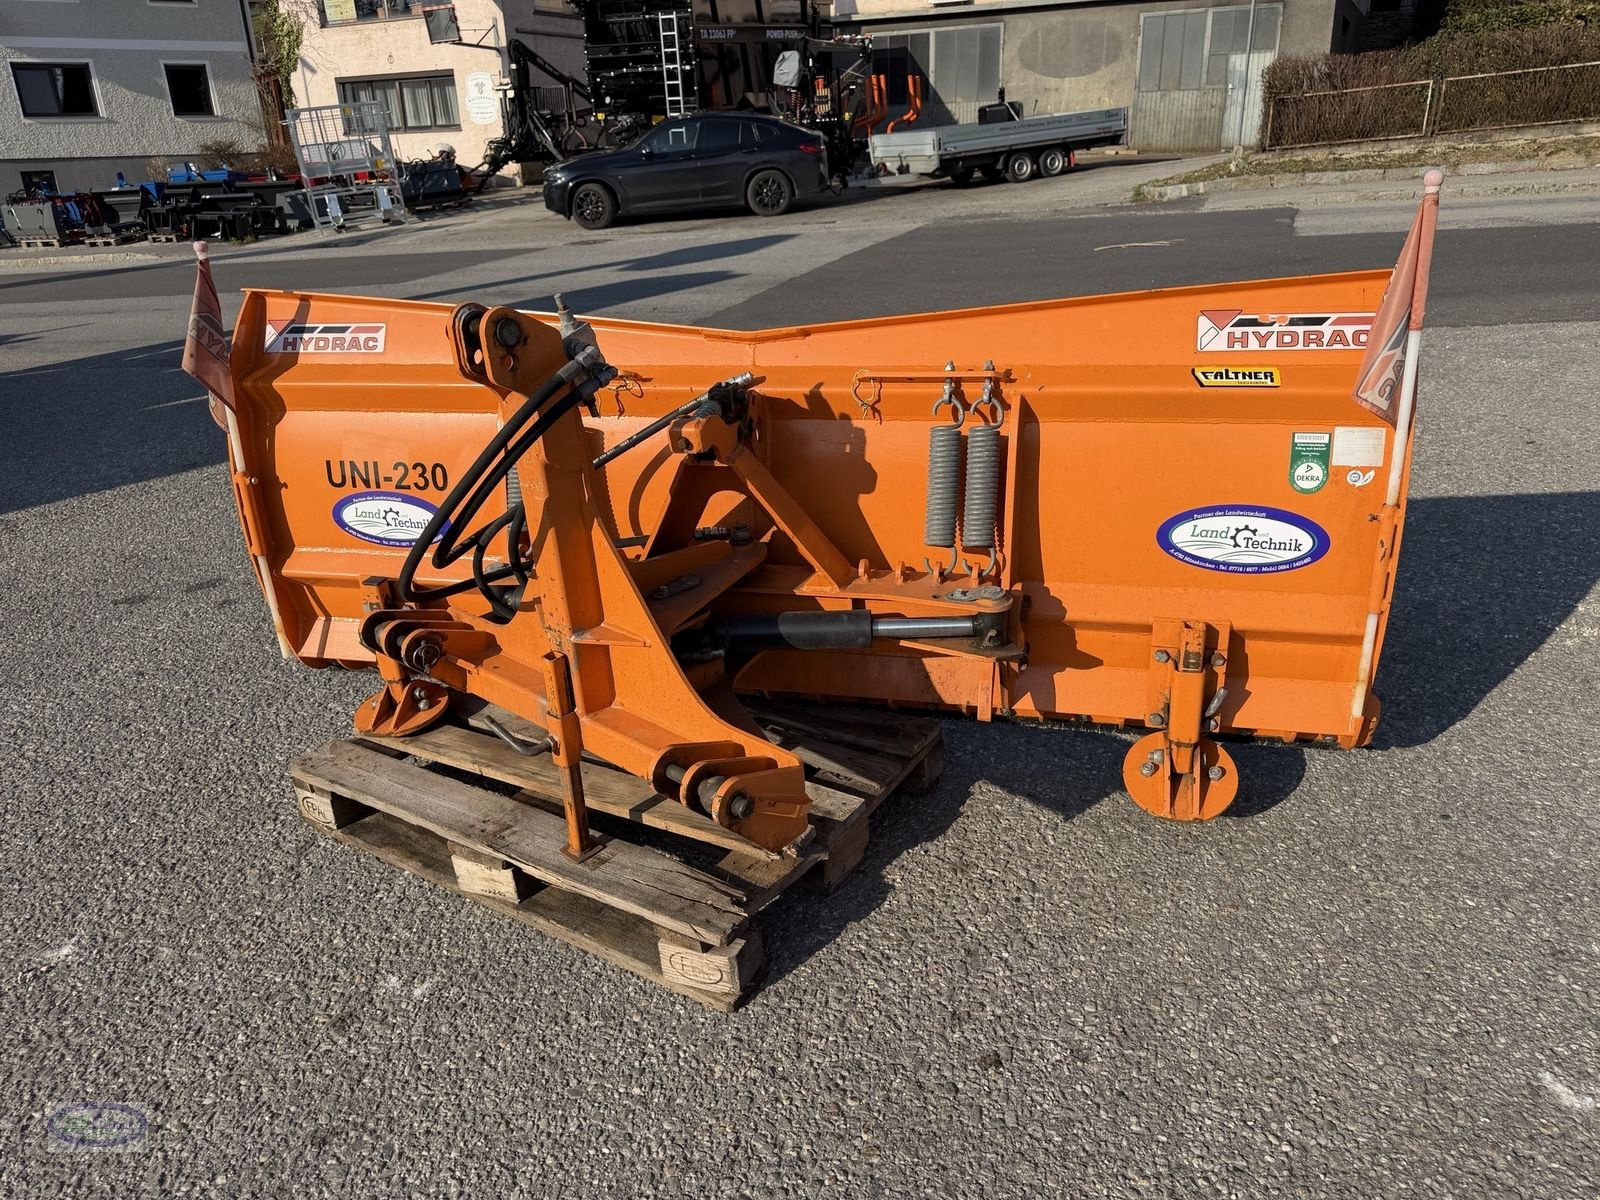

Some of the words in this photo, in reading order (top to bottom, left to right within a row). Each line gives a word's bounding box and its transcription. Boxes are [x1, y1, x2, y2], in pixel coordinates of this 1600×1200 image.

[766, 29, 784, 39] POWER
[282, 336, 379, 351] HYDRAC
[1227, 330, 1369, 348] HYDRAC
[1200, 368, 1275, 383] FALTNER
[326, 460, 448, 491] UNI-230
[355, 507, 381, 519] Land
[1193, 512, 1214, 520] Partner
[1225, 509, 1267, 518] Landwirtschaft
[1190, 524, 1231, 539] Land
[1243, 537, 1303, 552] Technik
